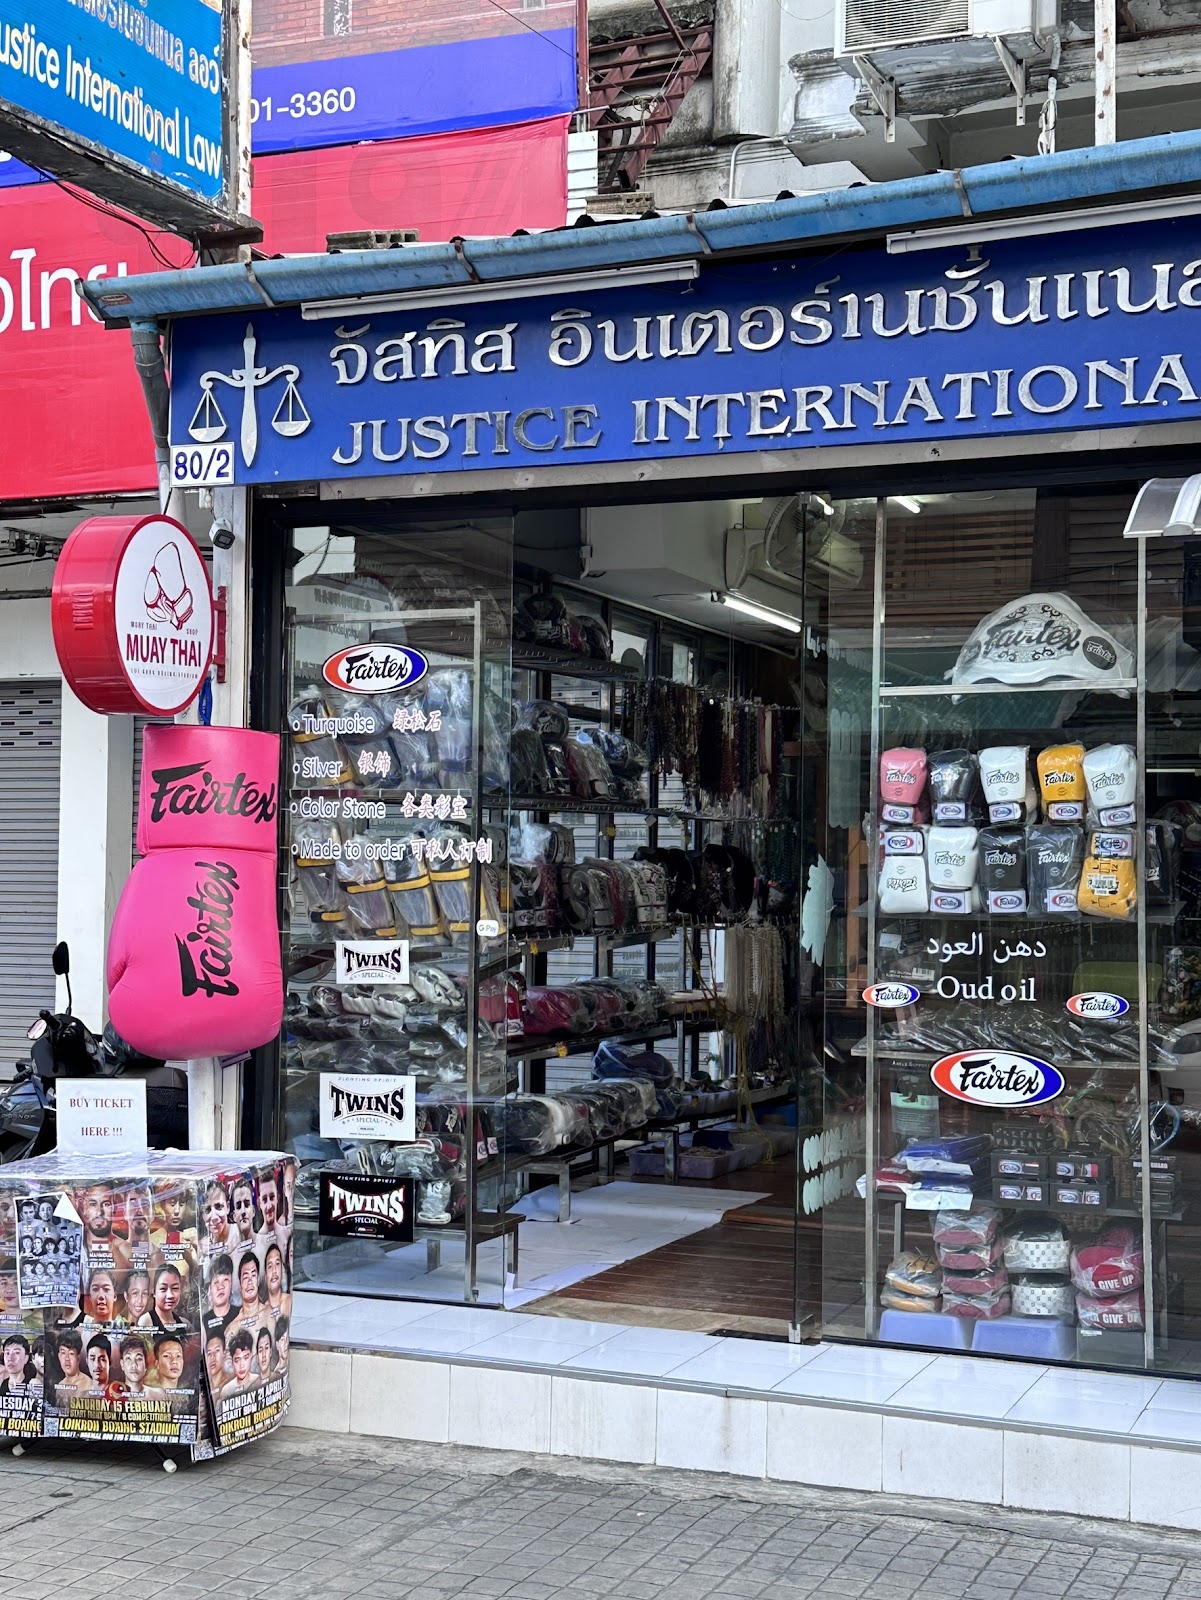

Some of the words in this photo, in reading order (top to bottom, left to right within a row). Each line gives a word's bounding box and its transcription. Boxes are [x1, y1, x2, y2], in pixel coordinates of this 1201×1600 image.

[65, 44, 181, 159] International
[184, 115, 222, 180] Law
[328, 317, 519, 386] จัสทิส
[332, 404, 603, 466] JUSTICE
[173, 450, 230, 482] 80/2
[982, 617, 1082, 658] Fairtex
[126, 633, 167, 664] MUAY
[170, 638, 202, 668] THAI
[345, 650, 409, 684] Fairtex
[302, 713, 375, 738] Turquoise
[393, 708, 442, 732] 绿松石
[302, 758, 342, 778] Silver
[357, 751, 391, 777] 银饰
[886, 769, 916, 784] Fairtex
[986, 769, 1020, 786] Fairtex
[1045, 770, 1076, 786] Fairtex
[1090, 773, 1125, 791] Fairtex
[150, 760, 277, 824] Fairtex
[300, 797, 339, 818] Color
[342, 799, 386, 819] Stone
[400, 792, 468, 820] 各类彩宝
[301, 839, 340, 860] Made
[345, 843, 364, 860] to
[366, 840, 406, 861] order
[410, 837, 493, 864] 可私人订制
[935, 851, 966, 866] Fairtex
[985, 850, 1017, 865] Fairtex
[1038, 850, 1070, 865] Fairtex
[175, 861, 240, 998] Fairtex
[926, 931, 983, 963] العود
[993, 940, 1047, 964] دهن
[342, 944, 403, 975] TWINS
[361, 971, 385, 979] SPECIAL
[875, 986, 910, 1003] Fairtex
[937, 975, 995, 1000] Oud
[1000, 977, 1038, 1002] oil
[1079, 996, 1119, 1012] Fairtex
[959, 1057, 1041, 1096] Fairtex
[69, 1098, 89, 1108] BUY
[93, 1098, 134, 1108] TICKET
[330, 1082, 405, 1121] TWINS
[81, 1126, 110, 1137] HERE
[329, 1181, 405, 1223] TWINS
[354, 1216, 379, 1225] SPECIAL
[133, 1262, 147, 1270] USA
[1098, 1279, 1120, 1290] GIVE
[1122, 1274, 1134, 1286] UP
[1102, 1313, 1124, 1324] GIVE
[70, 1397, 111, 1412] SATURDAY
[113, 1401, 123, 1412] 15
[125, 1400, 173, 1413] FEBRUARY
[221, 1391, 257, 1412] MONDAY
[265, 1379, 283, 1398] APRIL
[102, 1421, 136, 1434] BOXING
[139, 1422, 180, 1435] STADIUM
[219, 1417, 251, 1436] OIKROH
